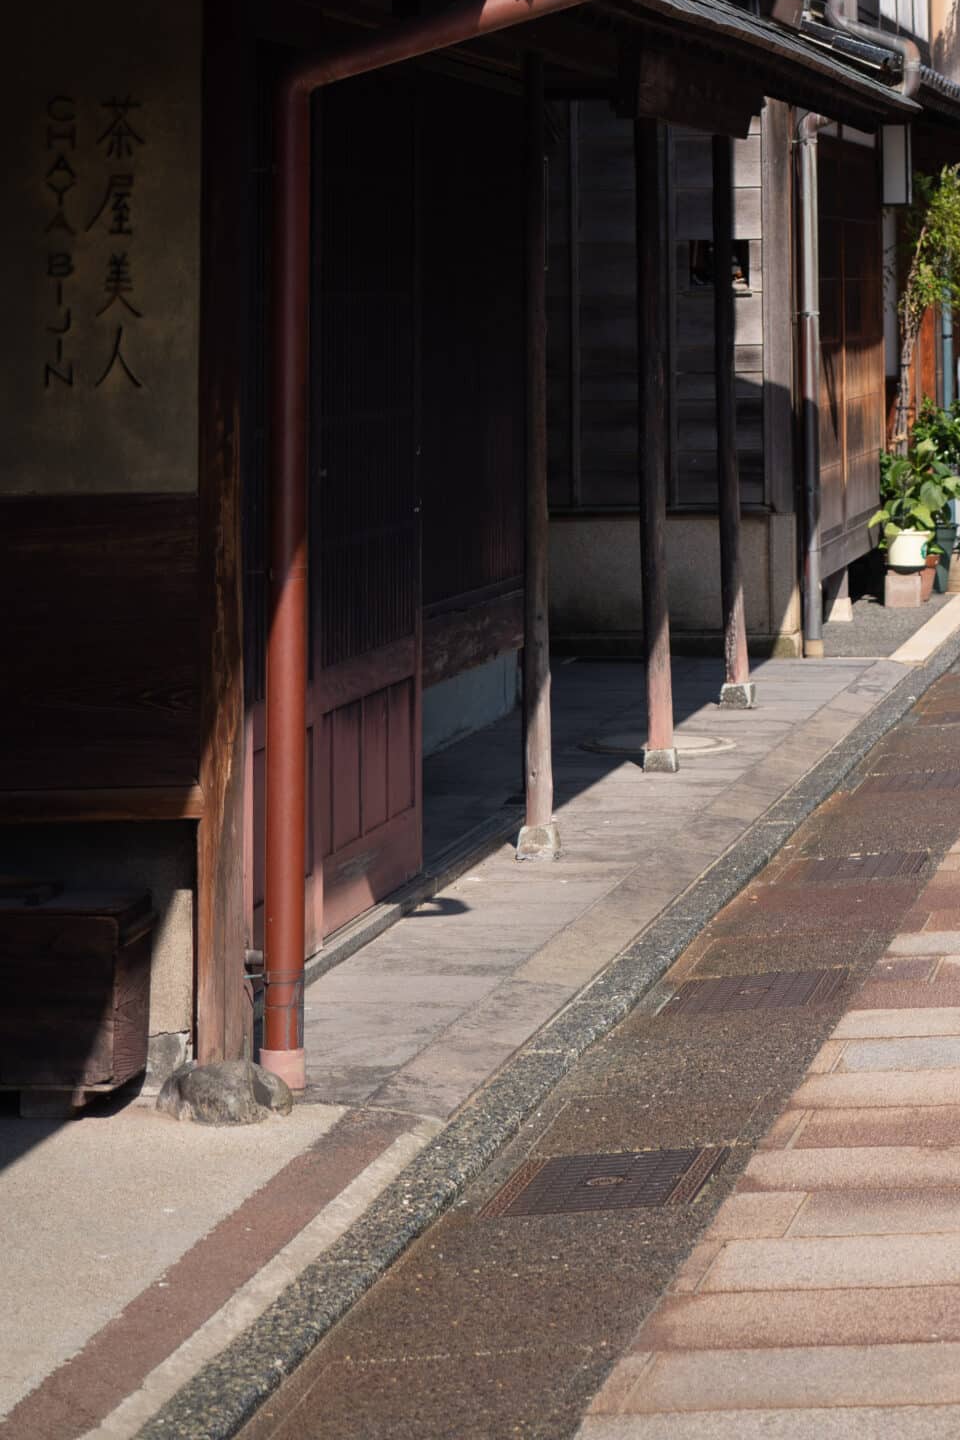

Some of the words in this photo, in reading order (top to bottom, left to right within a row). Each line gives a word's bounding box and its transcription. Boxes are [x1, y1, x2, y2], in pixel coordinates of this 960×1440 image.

[45, 95, 76, 236] CHAYA
[85, 94, 145, 388] 茶屋美人
[44, 253, 75, 388] BIJIN
